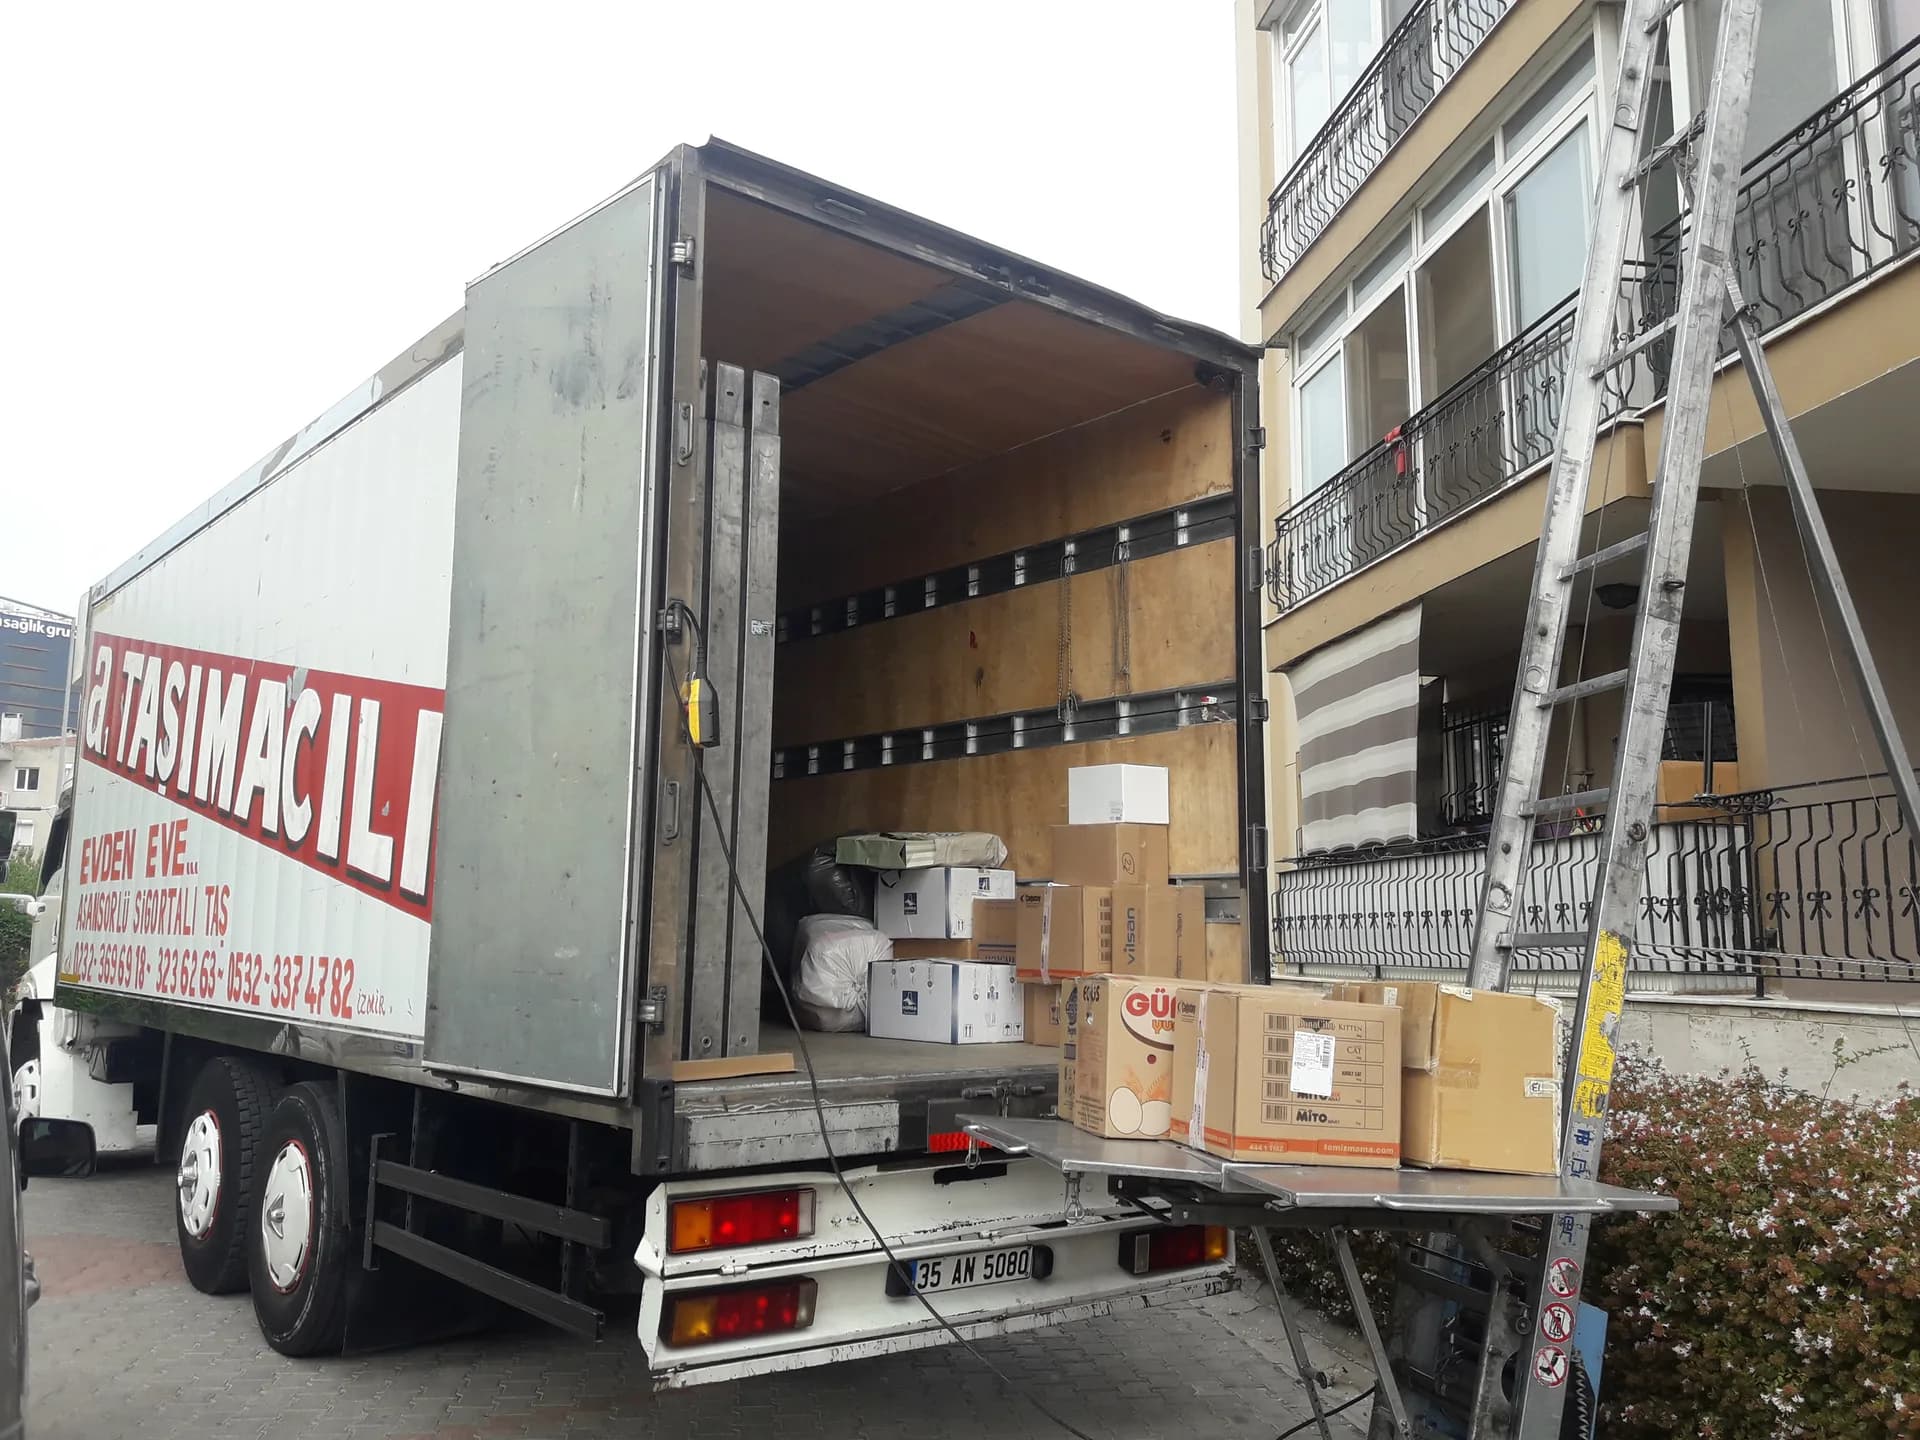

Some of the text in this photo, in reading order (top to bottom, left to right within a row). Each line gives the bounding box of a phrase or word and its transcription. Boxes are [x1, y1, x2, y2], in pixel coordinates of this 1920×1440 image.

[3, 618, 77, 639] sağlık gru
[79, 829, 137, 886] EVDEN
[205, 885, 231, 948] TAŞ
[1338, 1023, 1362, 1032] KITTEN
[1346, 1046, 1361, 1055] CAT
[917, 1250, 1029, 1289] 35 AN 5080
